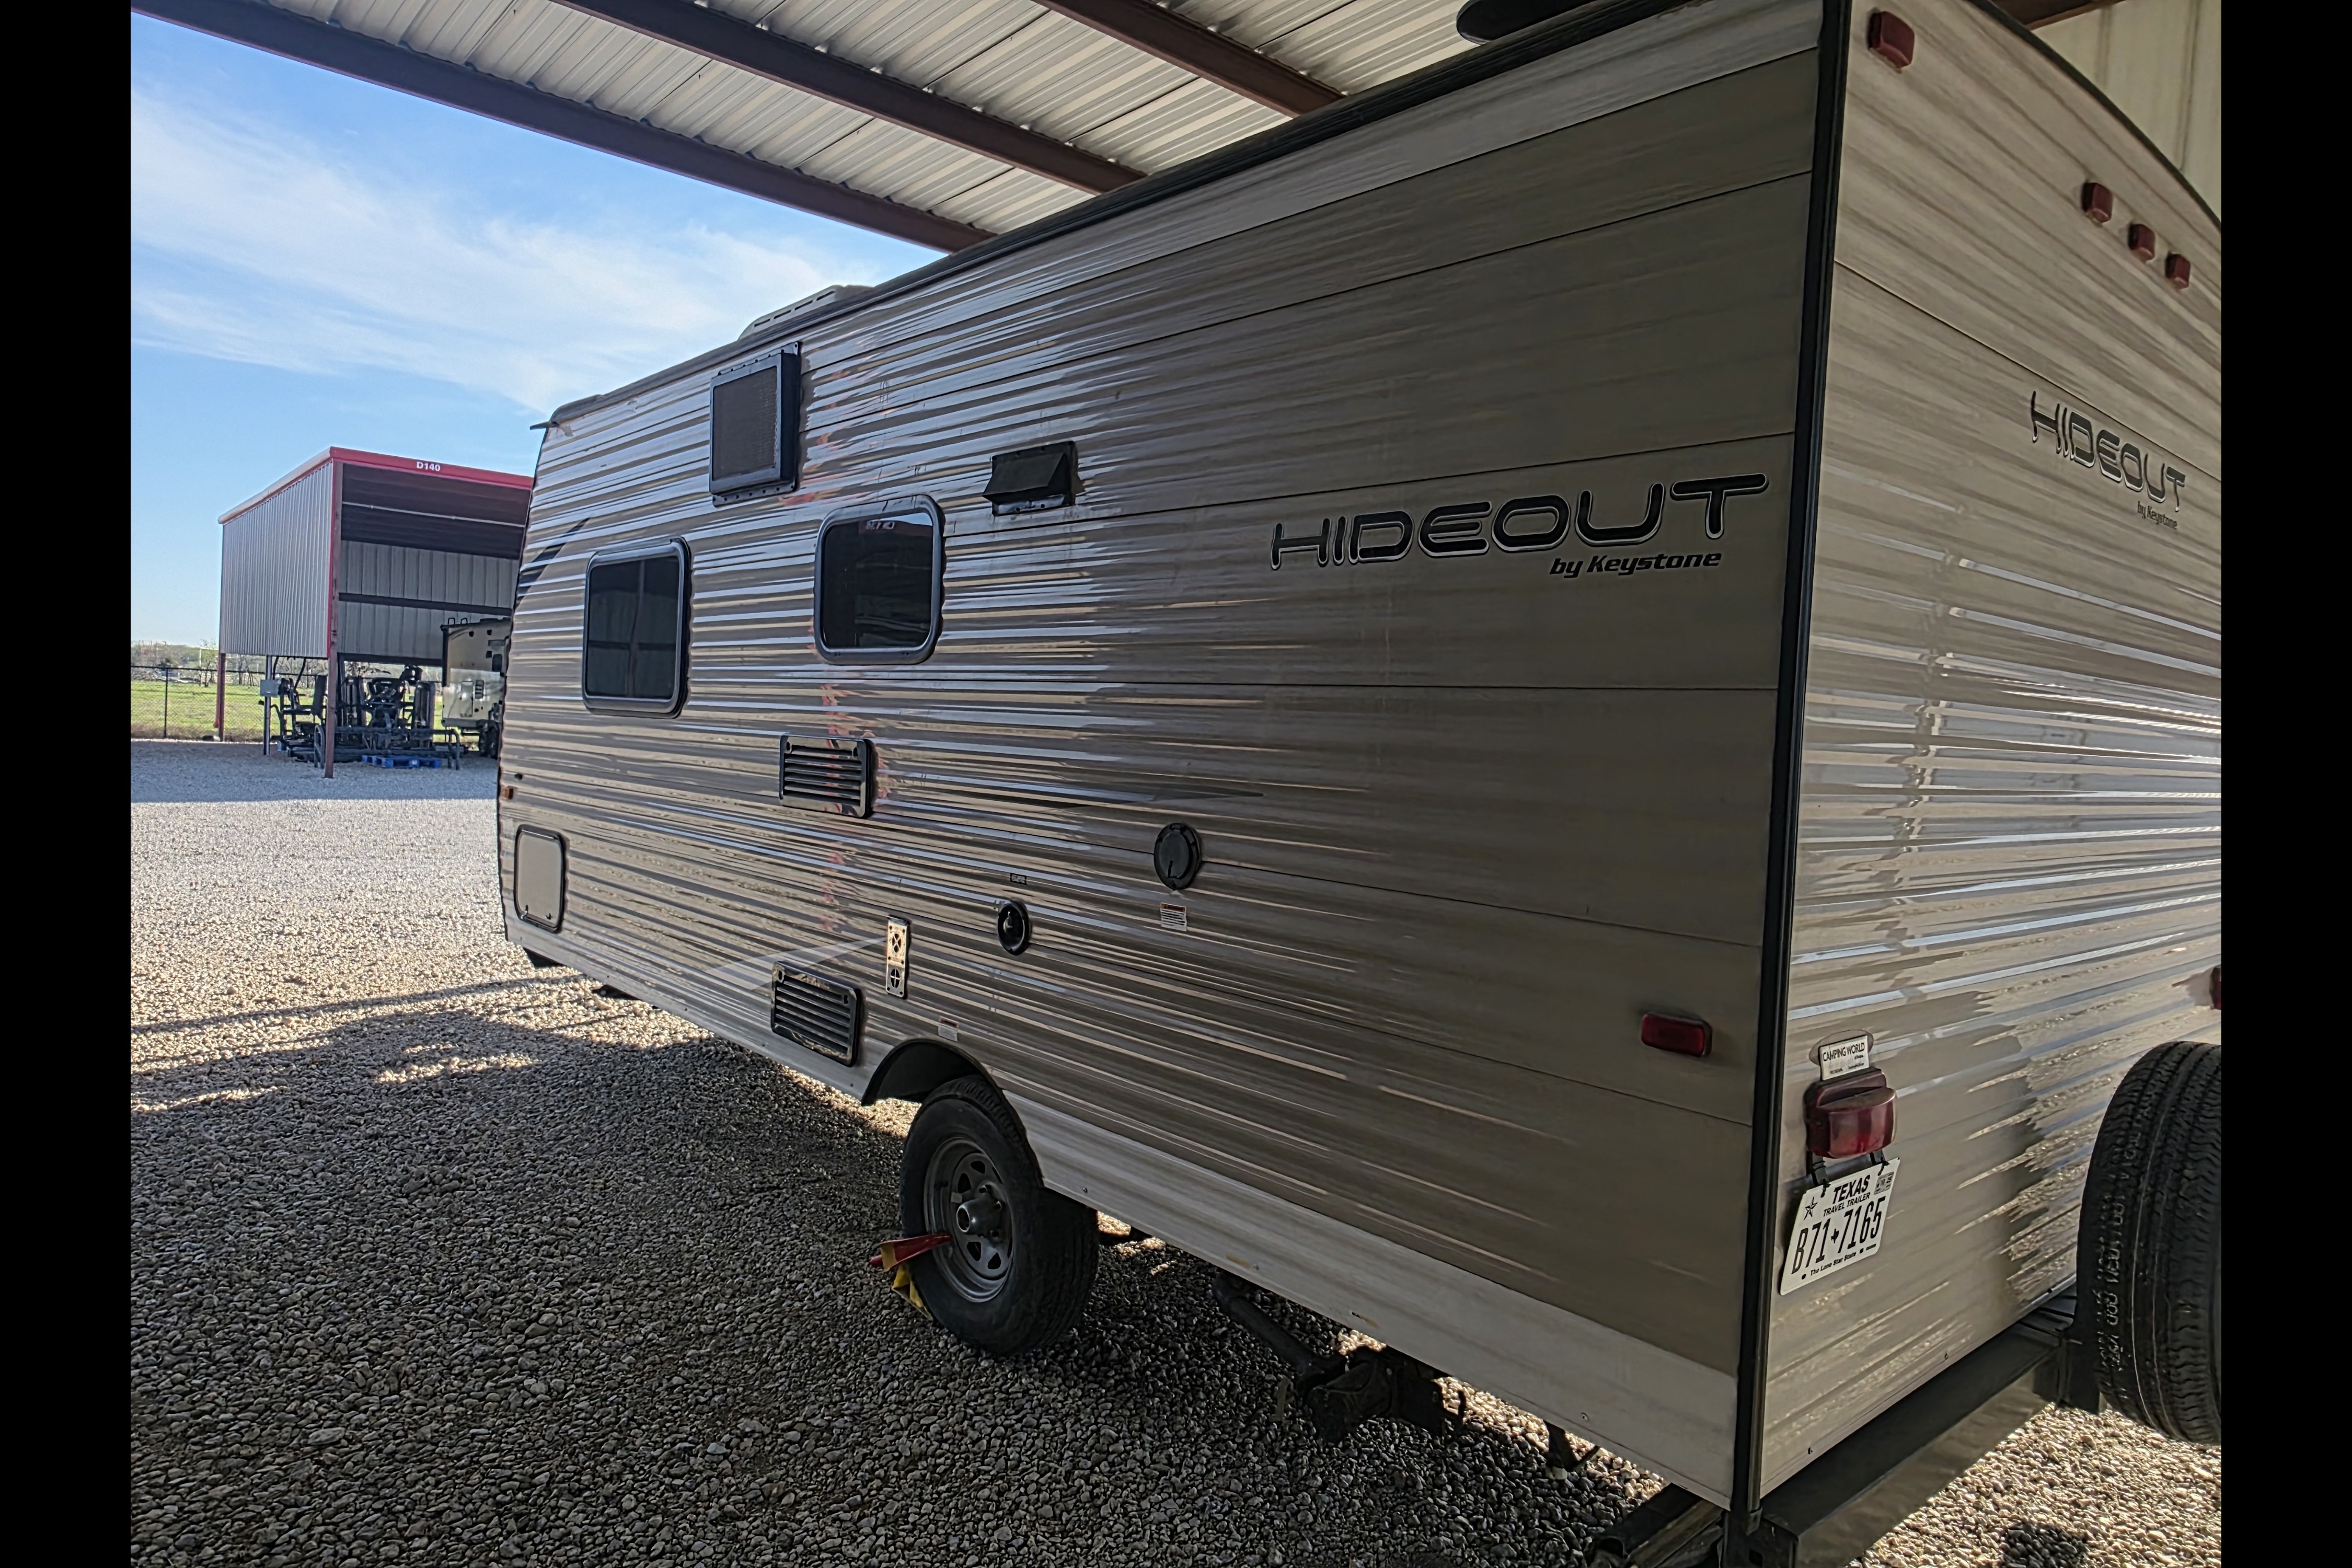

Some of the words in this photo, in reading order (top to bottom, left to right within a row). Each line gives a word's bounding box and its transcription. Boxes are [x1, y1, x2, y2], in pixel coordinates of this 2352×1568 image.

[2031, 390, 2186, 513] HIDEOUT
[416, 461, 441, 471] D140
[1271, 472, 1768, 570] HIDEOUT
[2137, 501, 2146, 519] by
[1549, 558, 1584, 579] by
[1586, 552, 1722, 576] Keystone
[1823, 1047, 1846, 1062] CAMPING
[1847, 1042, 1865, 1055] WORLD
[1832, 1174, 1871, 1204] TEXAS
[1823, 1203, 1845, 1217] TRAVEL
[1847, 1192, 1871, 1207] TRAILER
[1810, 1267, 1820, 1276] The
[1833, 1257, 1843, 1265] Star
